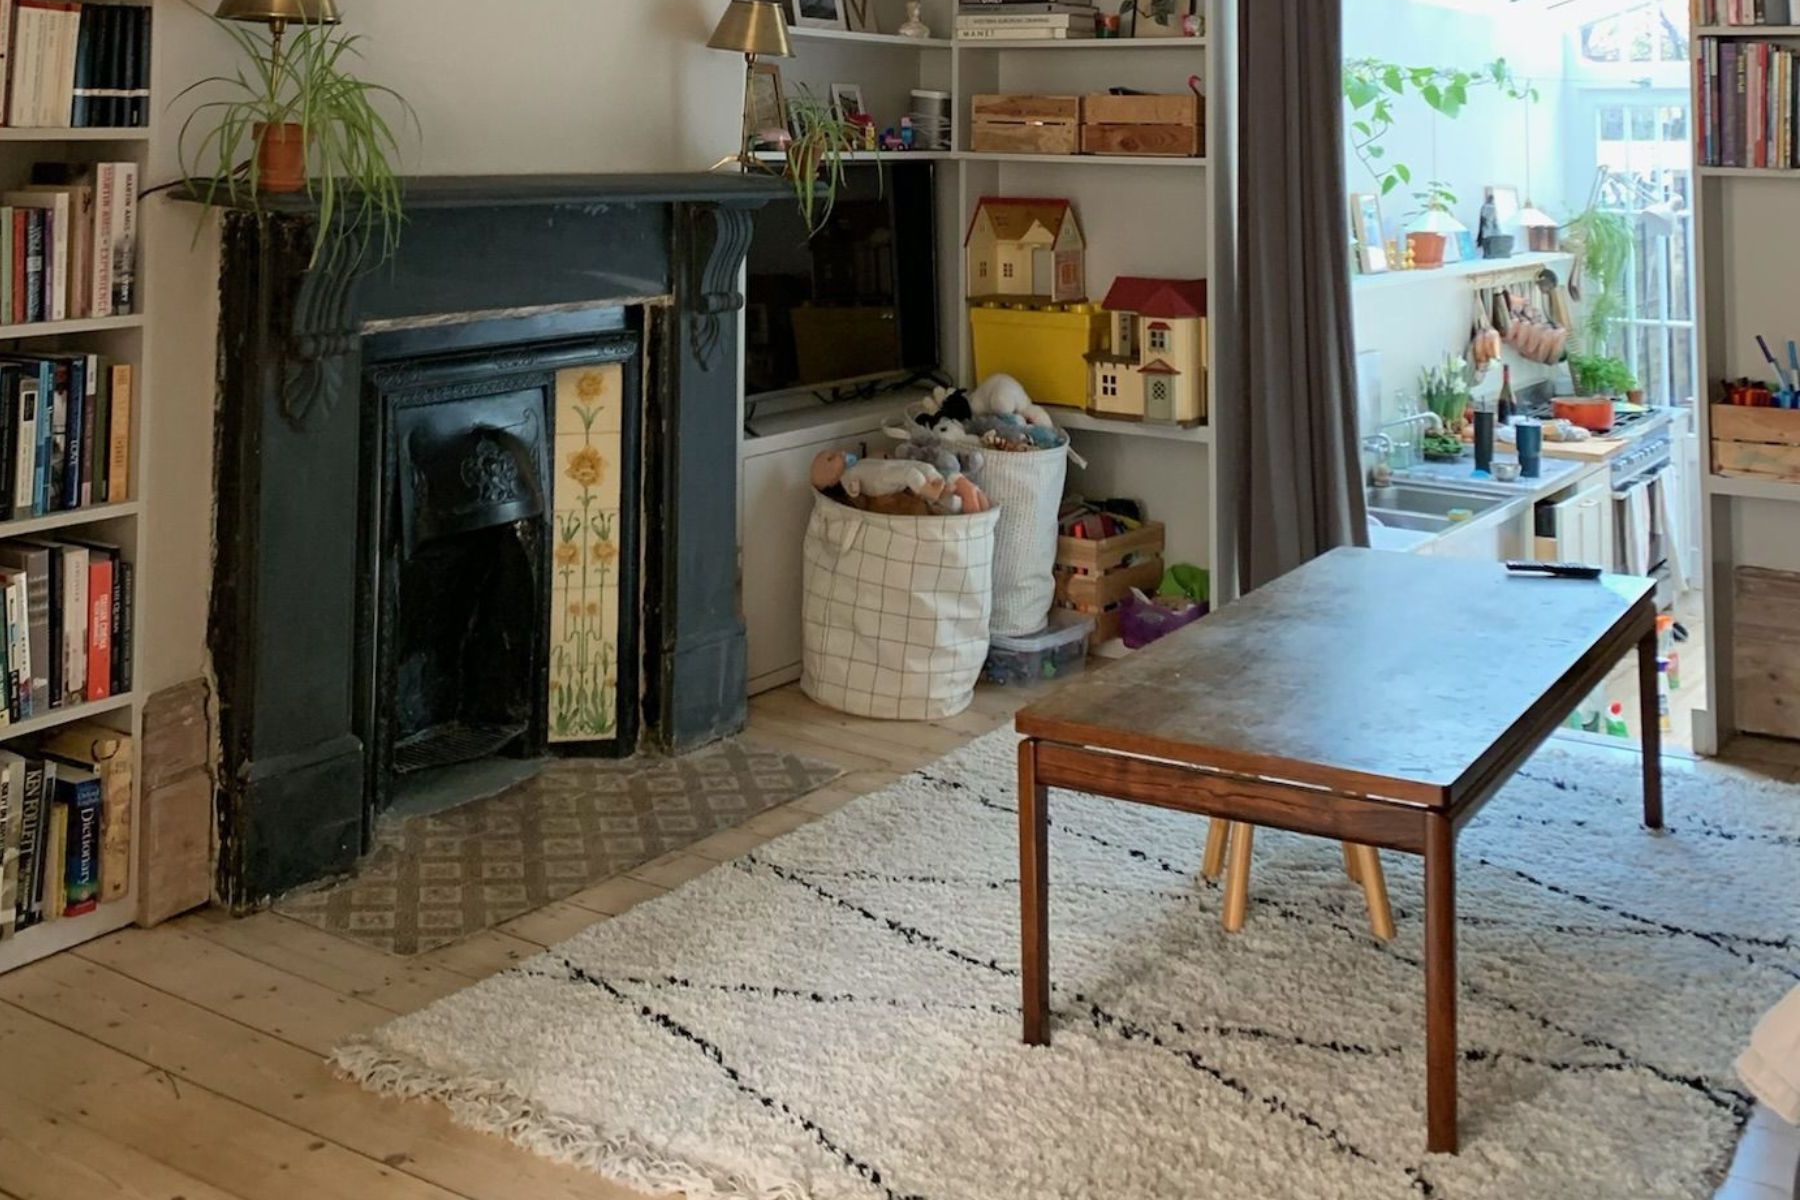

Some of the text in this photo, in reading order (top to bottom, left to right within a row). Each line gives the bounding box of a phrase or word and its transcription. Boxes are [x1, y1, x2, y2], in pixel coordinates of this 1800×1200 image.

[125, 173, 133, 206] MARTIN
[98, 247, 109, 314] EXPERIENCE
[25, 770, 43, 797] KEN
[19, 801, 39, 855] FOLLETT
[78, 807, 95, 885] Dictionary
